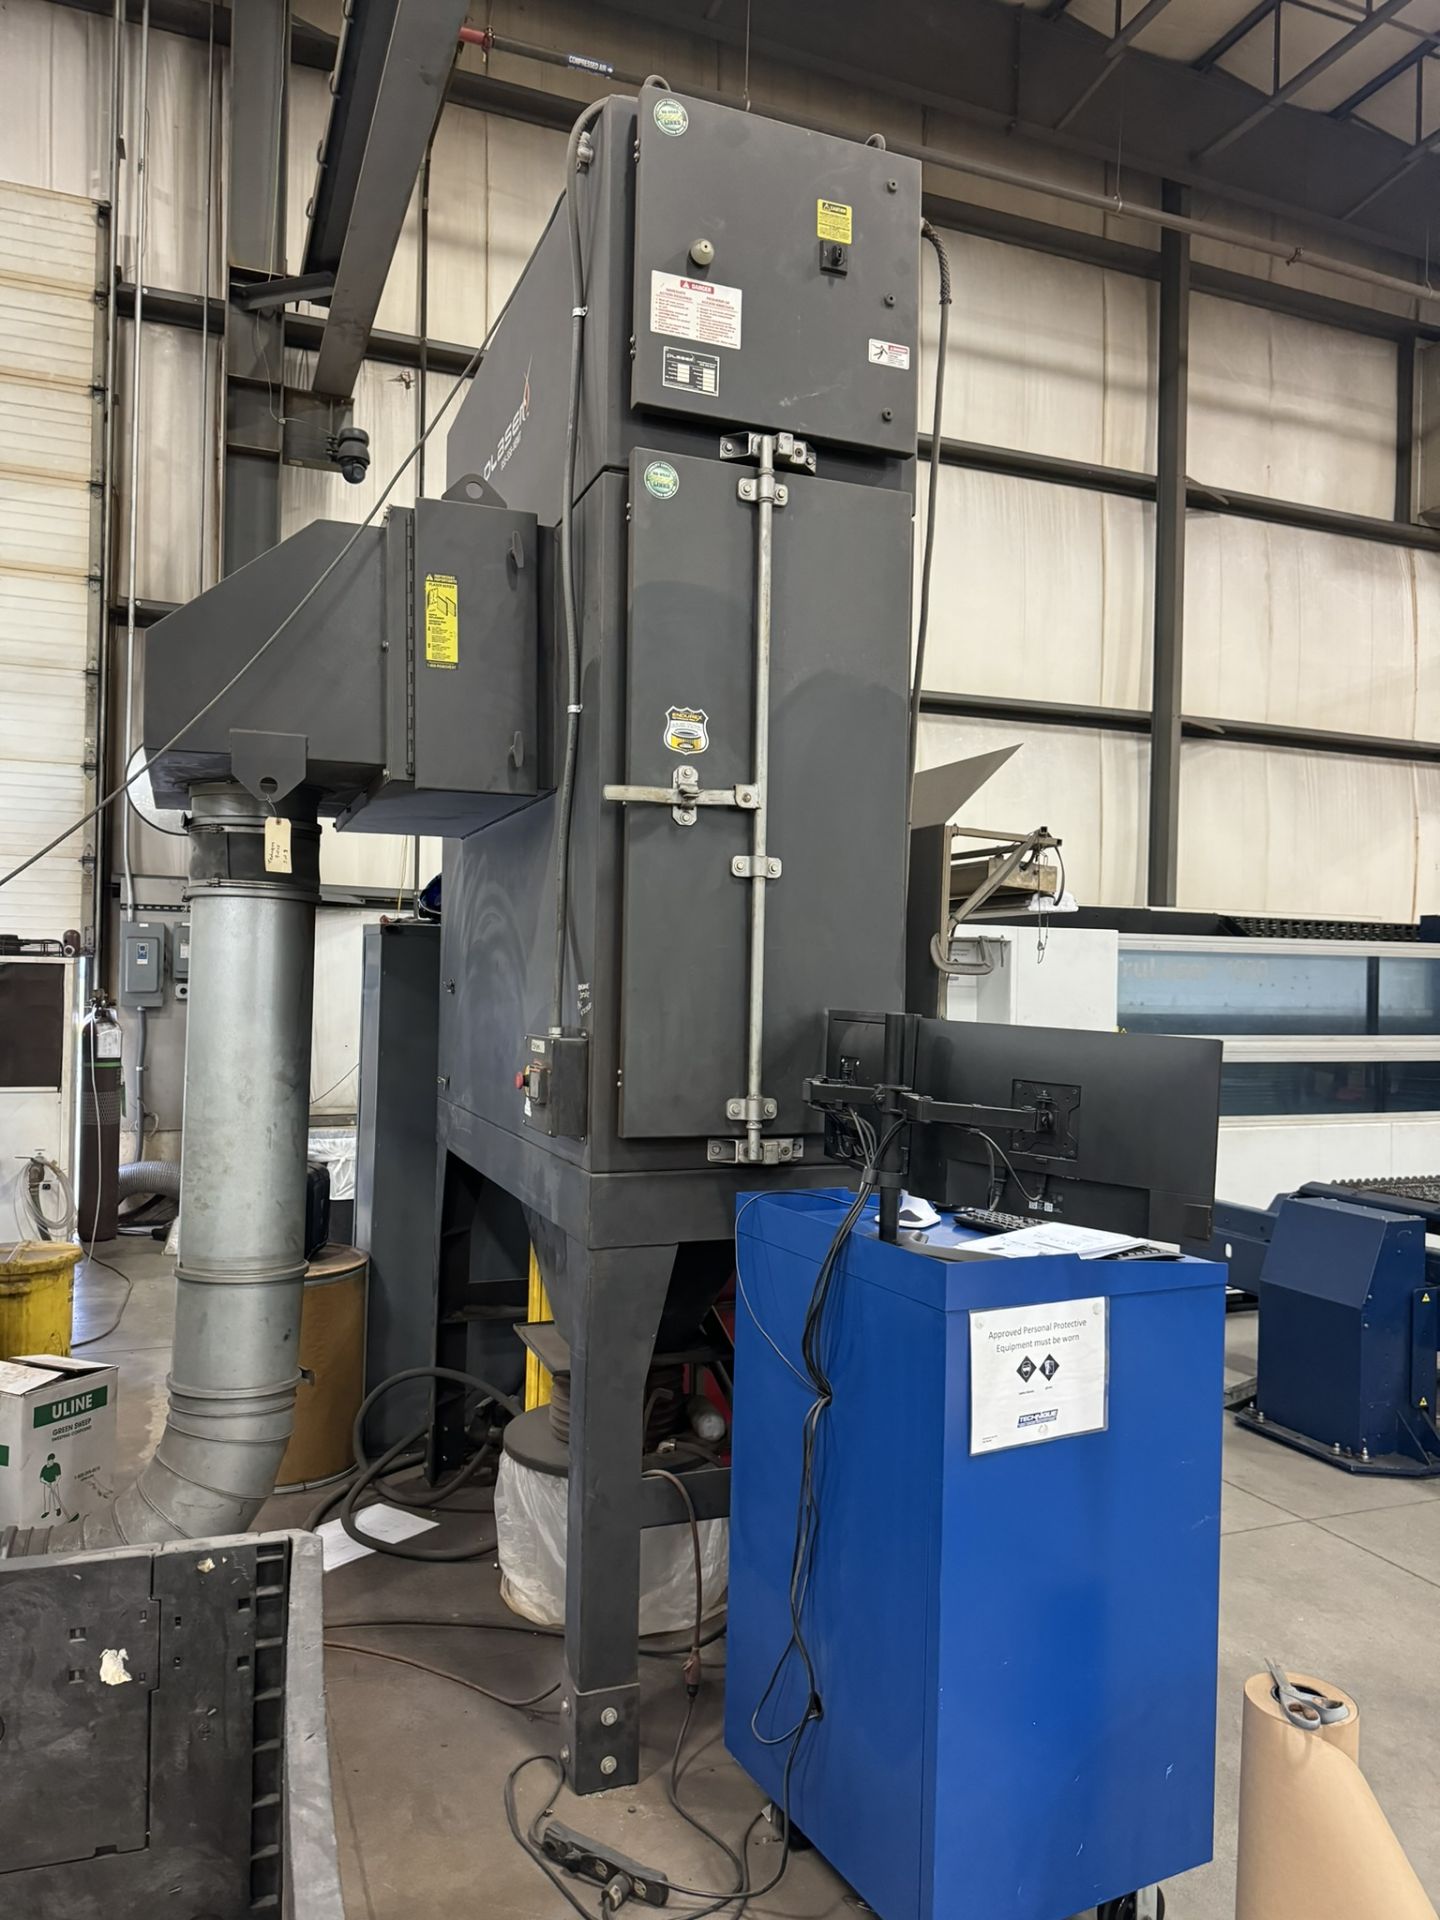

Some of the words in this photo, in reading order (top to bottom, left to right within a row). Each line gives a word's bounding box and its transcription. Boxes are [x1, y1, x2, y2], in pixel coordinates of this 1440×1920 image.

[988, 1327, 1022, 1340] Approved
[1023, 1324, 1052, 1335] Personal
[1053, 1318, 1087, 1330] Protective
[996, 1340, 1033, 1353] Equipment
[1034, 1337, 1051, 1347] must
[1052, 1335, 1061, 1344] be
[1062, 1333, 1080, 1343] worn
[52, 1393, 92, 1419] ULINE
[52, 1423, 73, 1436] GREEN
[74, 1417, 92, 1430] SWEEP
